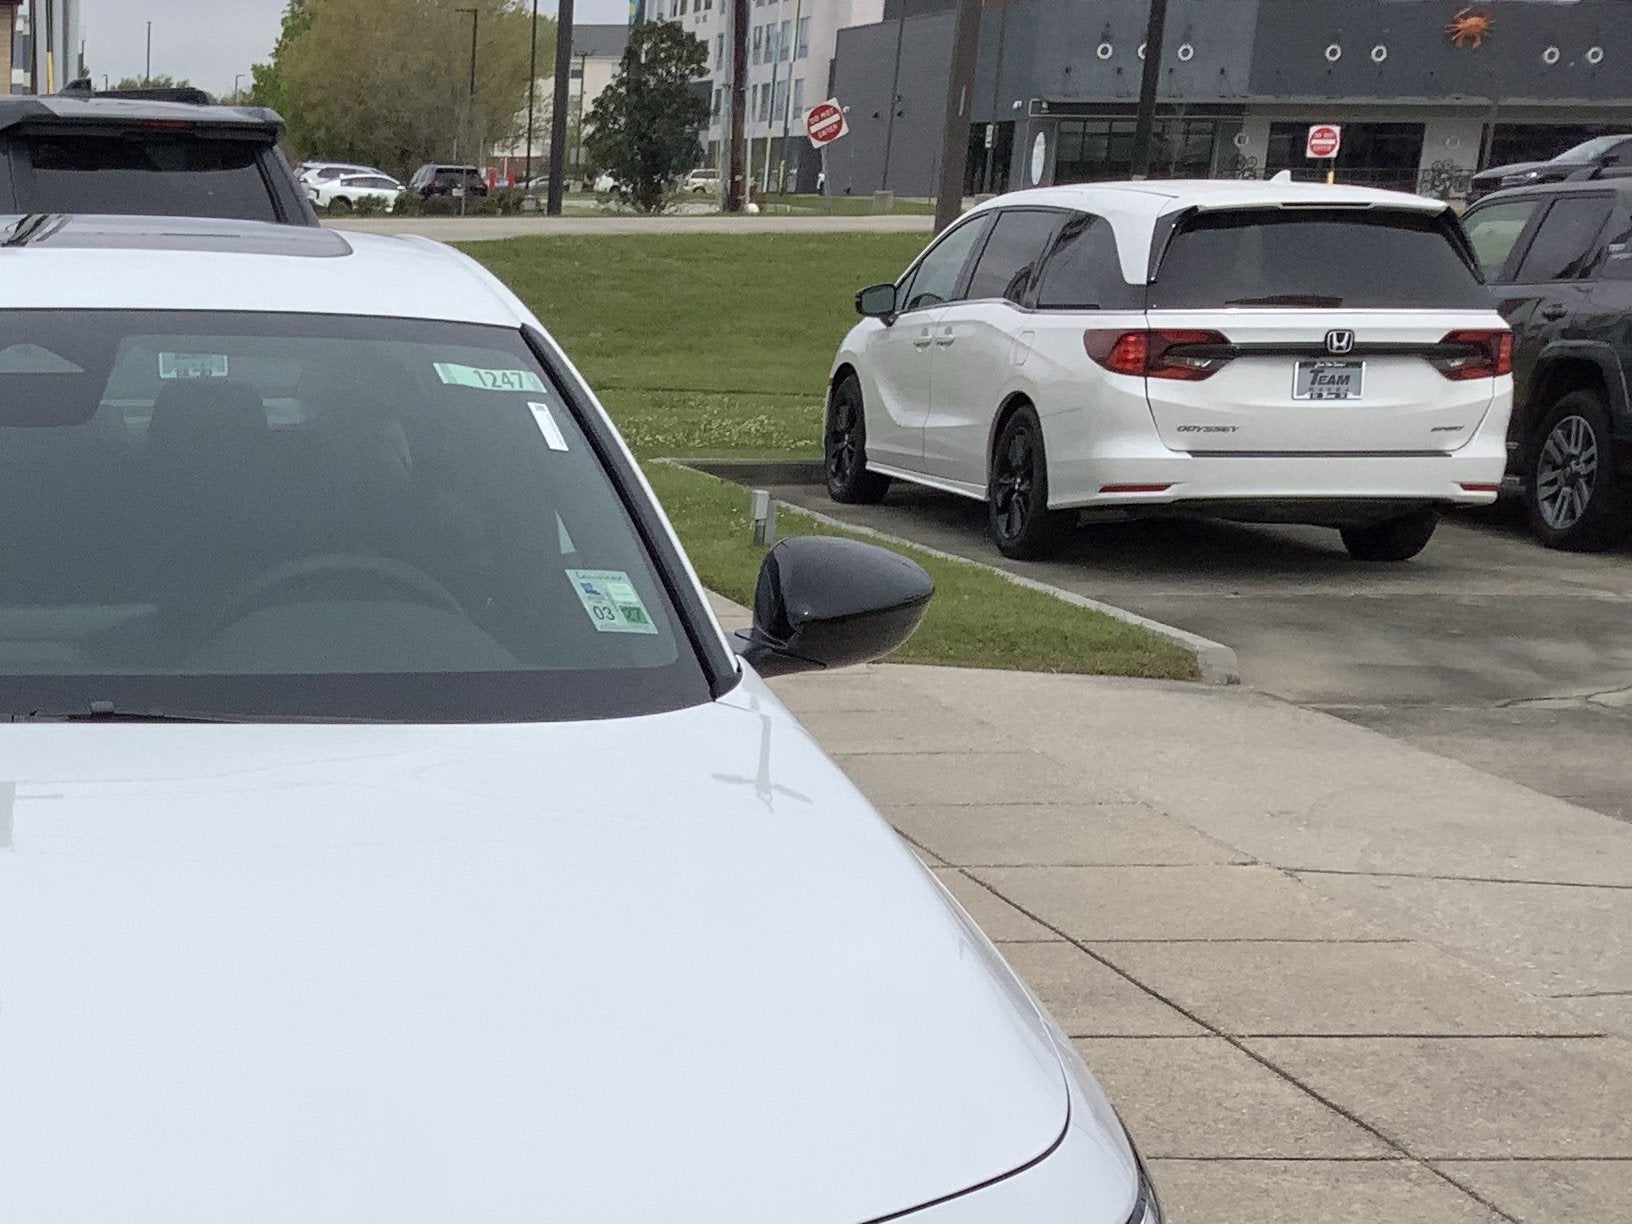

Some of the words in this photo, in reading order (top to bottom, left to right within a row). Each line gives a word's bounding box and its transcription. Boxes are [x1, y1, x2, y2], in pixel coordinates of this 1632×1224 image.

[809, 114, 820, 124] DO
[820, 107, 834, 118] NOT
[817, 123, 838, 138] ENTER
[473, 370, 523, 389] 1247
[1309, 368, 1351, 386] TEAM
[592, 605, 615, 621] 03
